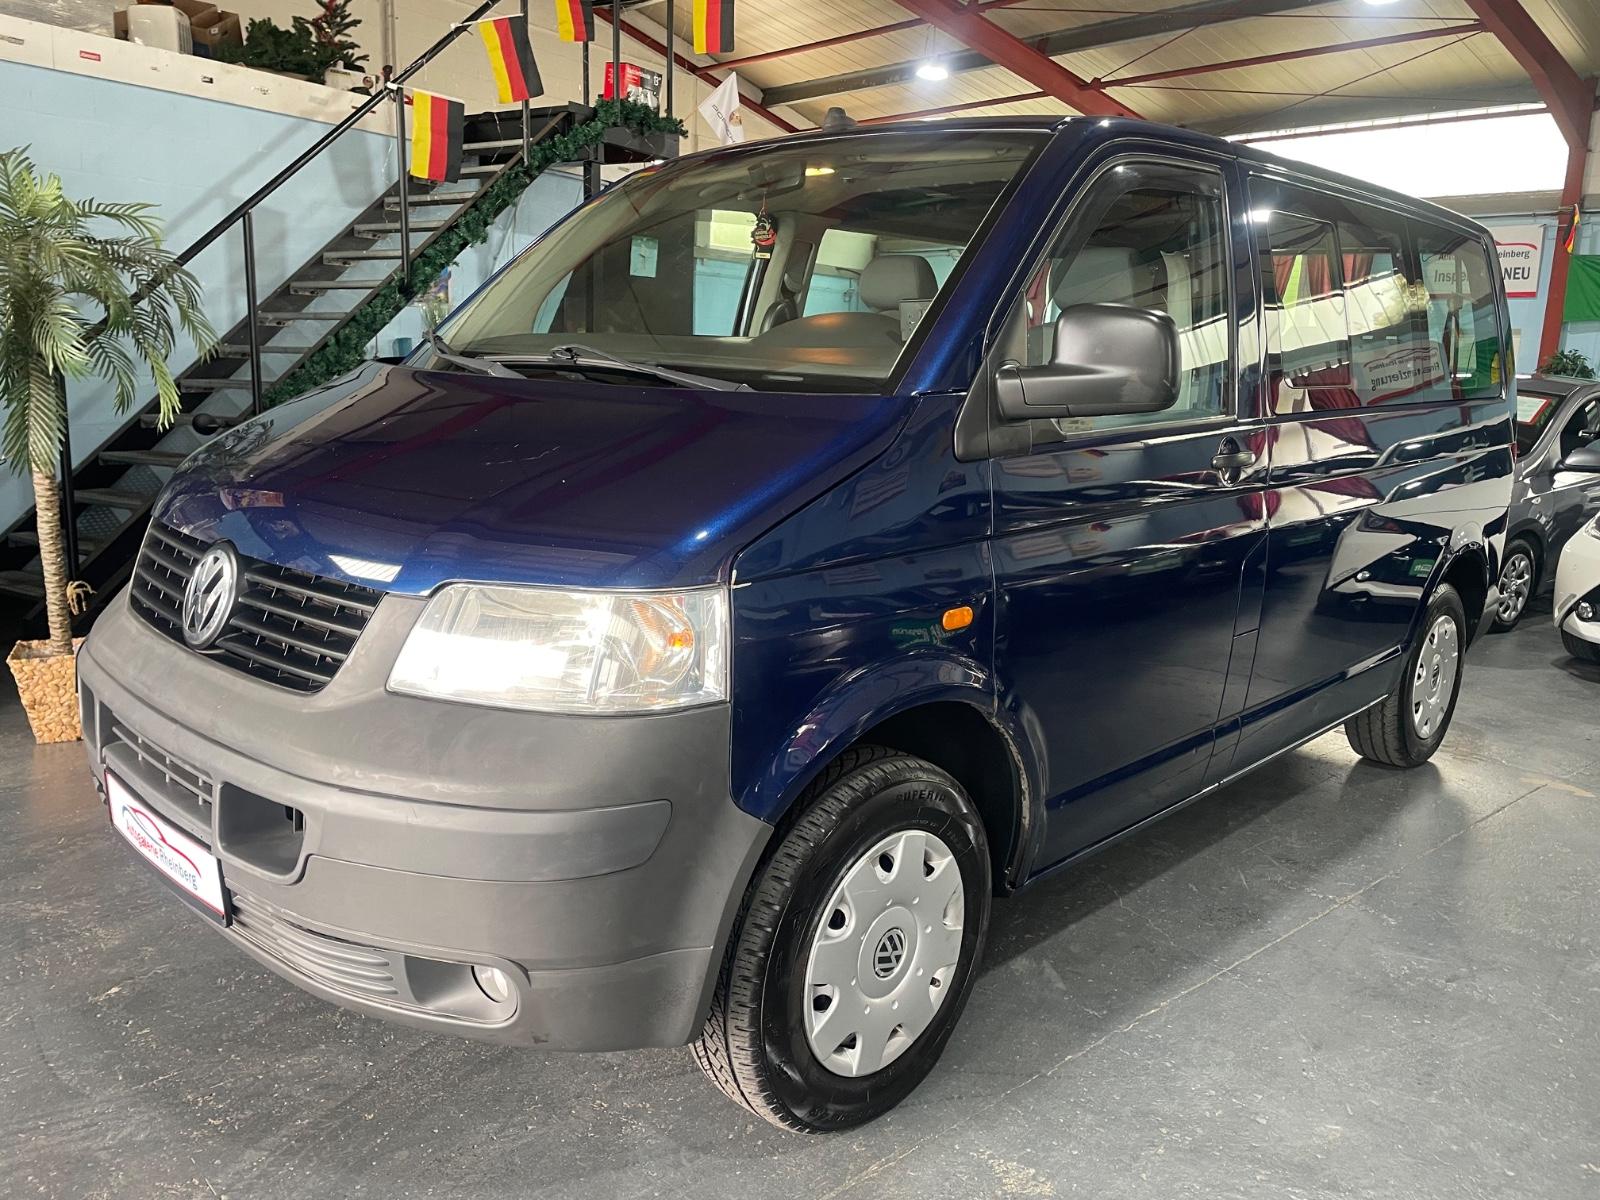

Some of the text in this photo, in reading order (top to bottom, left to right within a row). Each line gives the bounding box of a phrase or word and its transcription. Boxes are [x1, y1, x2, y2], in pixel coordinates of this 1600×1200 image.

[1498, 249, 1530, 260] einberg
[1503, 266, 1531, 280] NEU
[158, 847, 198, 891] Rheinberg
